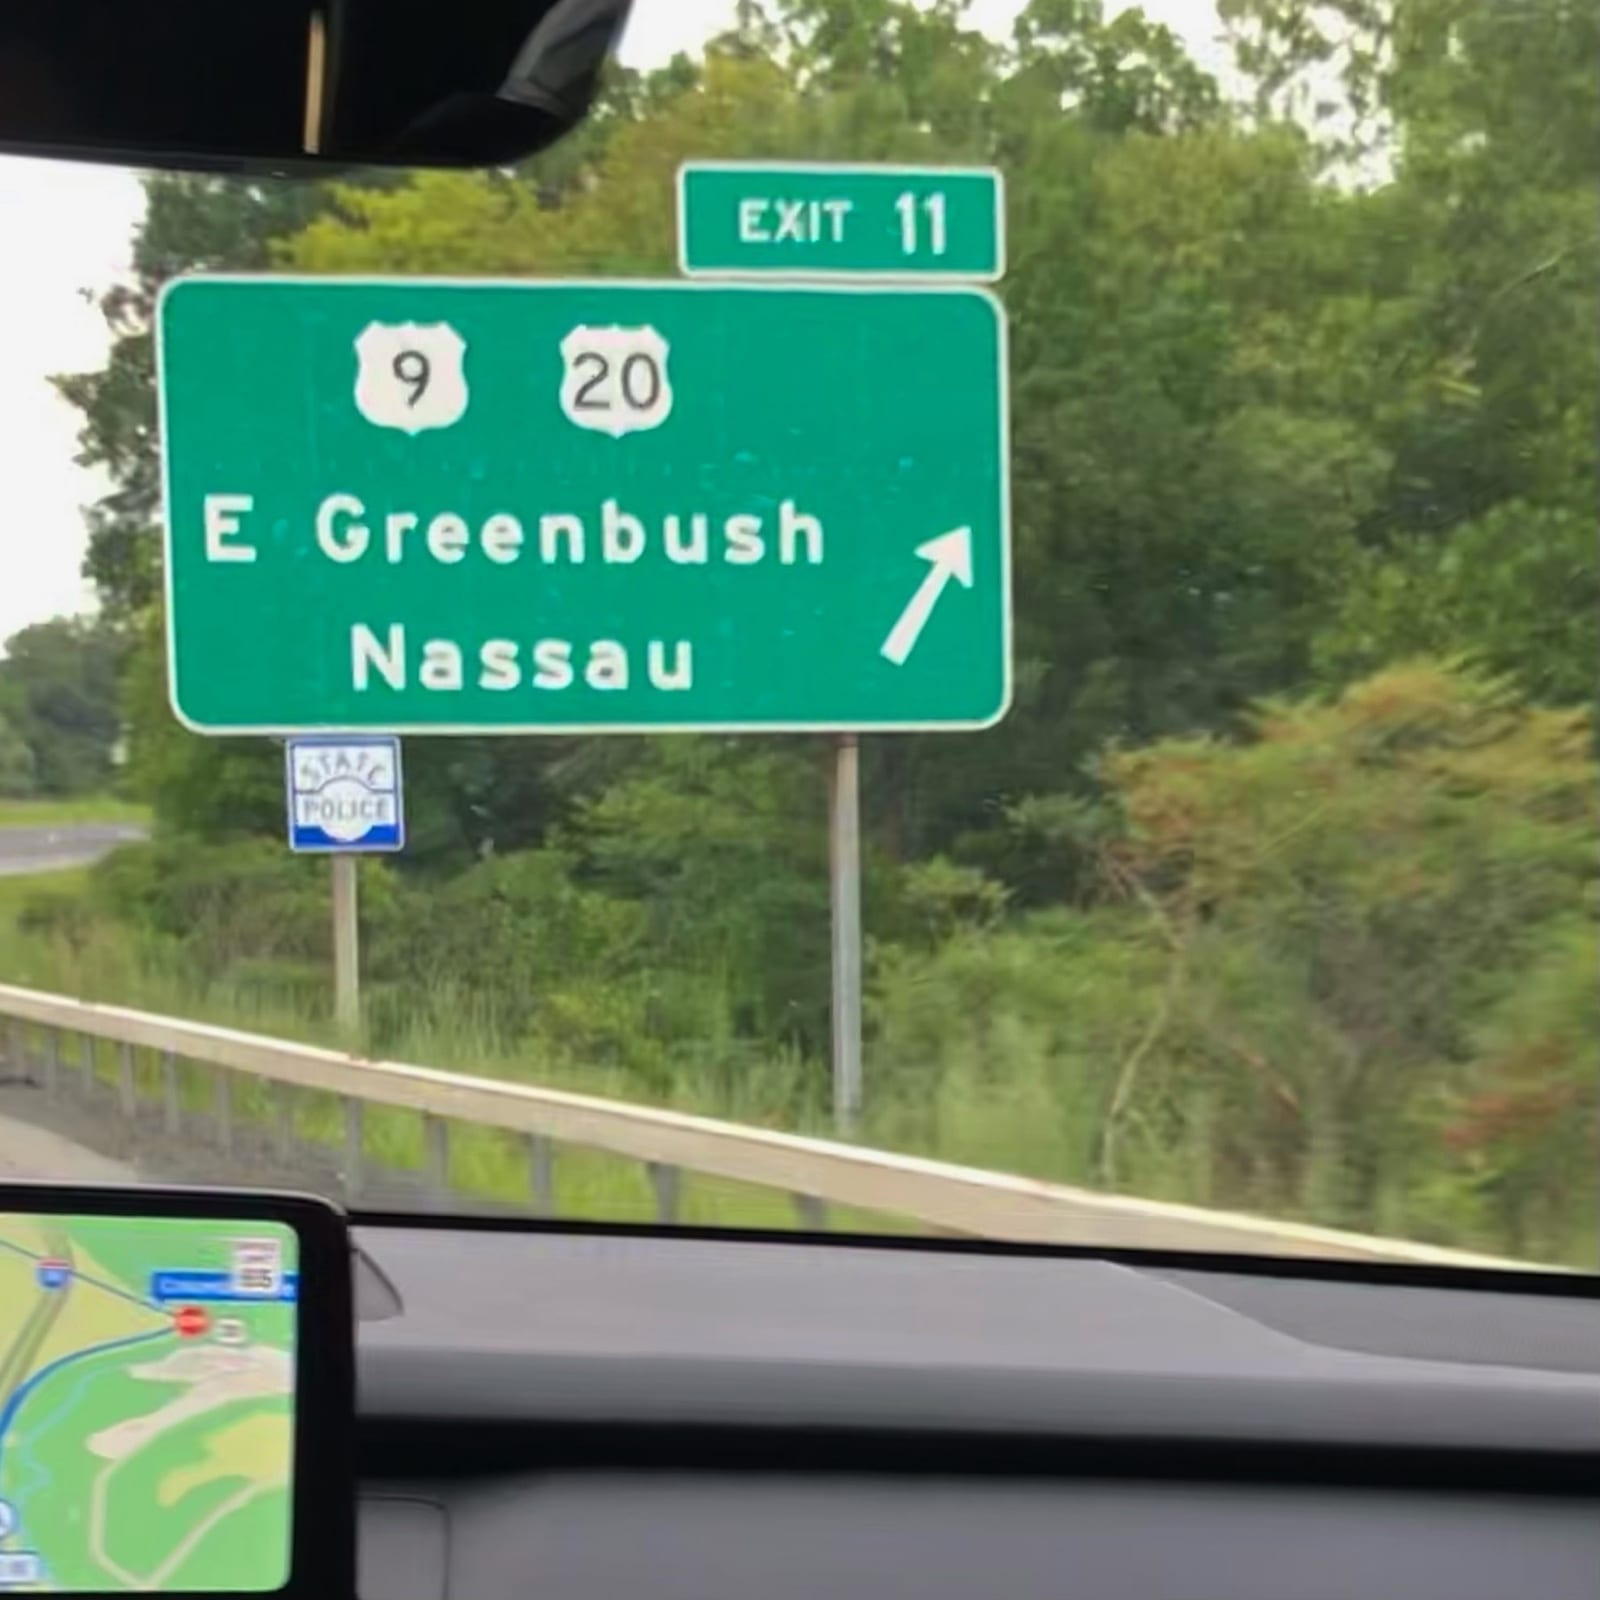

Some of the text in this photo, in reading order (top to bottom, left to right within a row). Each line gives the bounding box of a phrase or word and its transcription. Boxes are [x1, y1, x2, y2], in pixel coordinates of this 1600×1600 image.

[738, 192, 945, 255] EXIT 11
[392, 350, 660, 410] 9 20
[204, 494, 823, 564] E Greenbush
[351, 623, 692, 691] Nassau
[303, 798, 389, 820] POLICE
